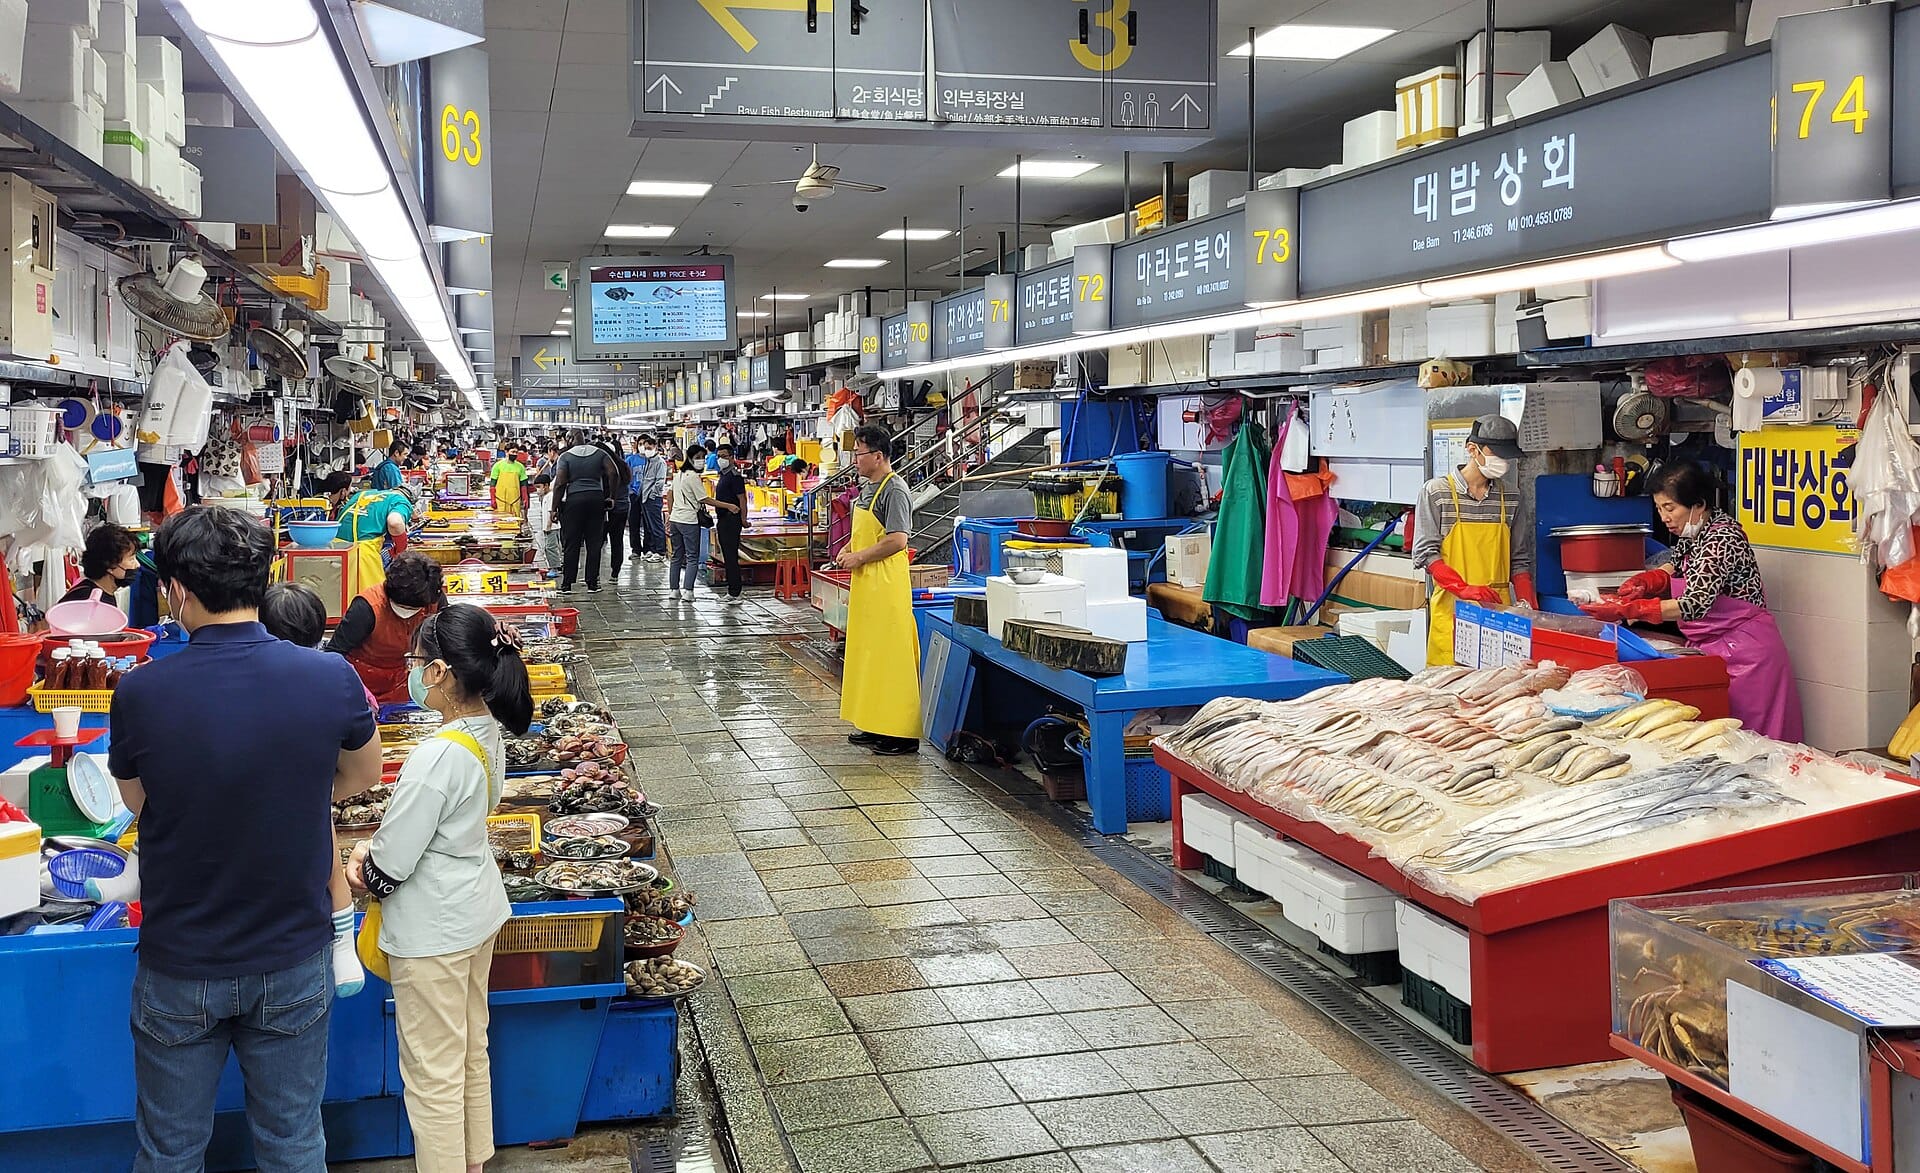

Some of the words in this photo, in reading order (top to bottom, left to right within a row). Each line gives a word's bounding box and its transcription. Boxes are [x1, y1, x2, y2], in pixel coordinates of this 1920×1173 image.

[943, 89, 1025, 110] 외부화장실
[1791, 74, 1870, 140] 74
[440, 103, 483, 167] 63
[1412, 132, 1576, 223] 대밤상회
[1136, 230, 1231, 287] 마라도복어
[1253, 228, 1290, 264] 73
[1412, 239, 1425, 251] Dae
[1426, 236, 1440, 249] Bam
[1025, 274, 1074, 313] 마라도복
[1077, 273, 1105, 302] 72
[990, 299, 1009, 323] 71
[862, 336, 878, 355] 69
[909, 322, 929, 343] 70
[1742, 447, 1858, 533] 대밤상회
